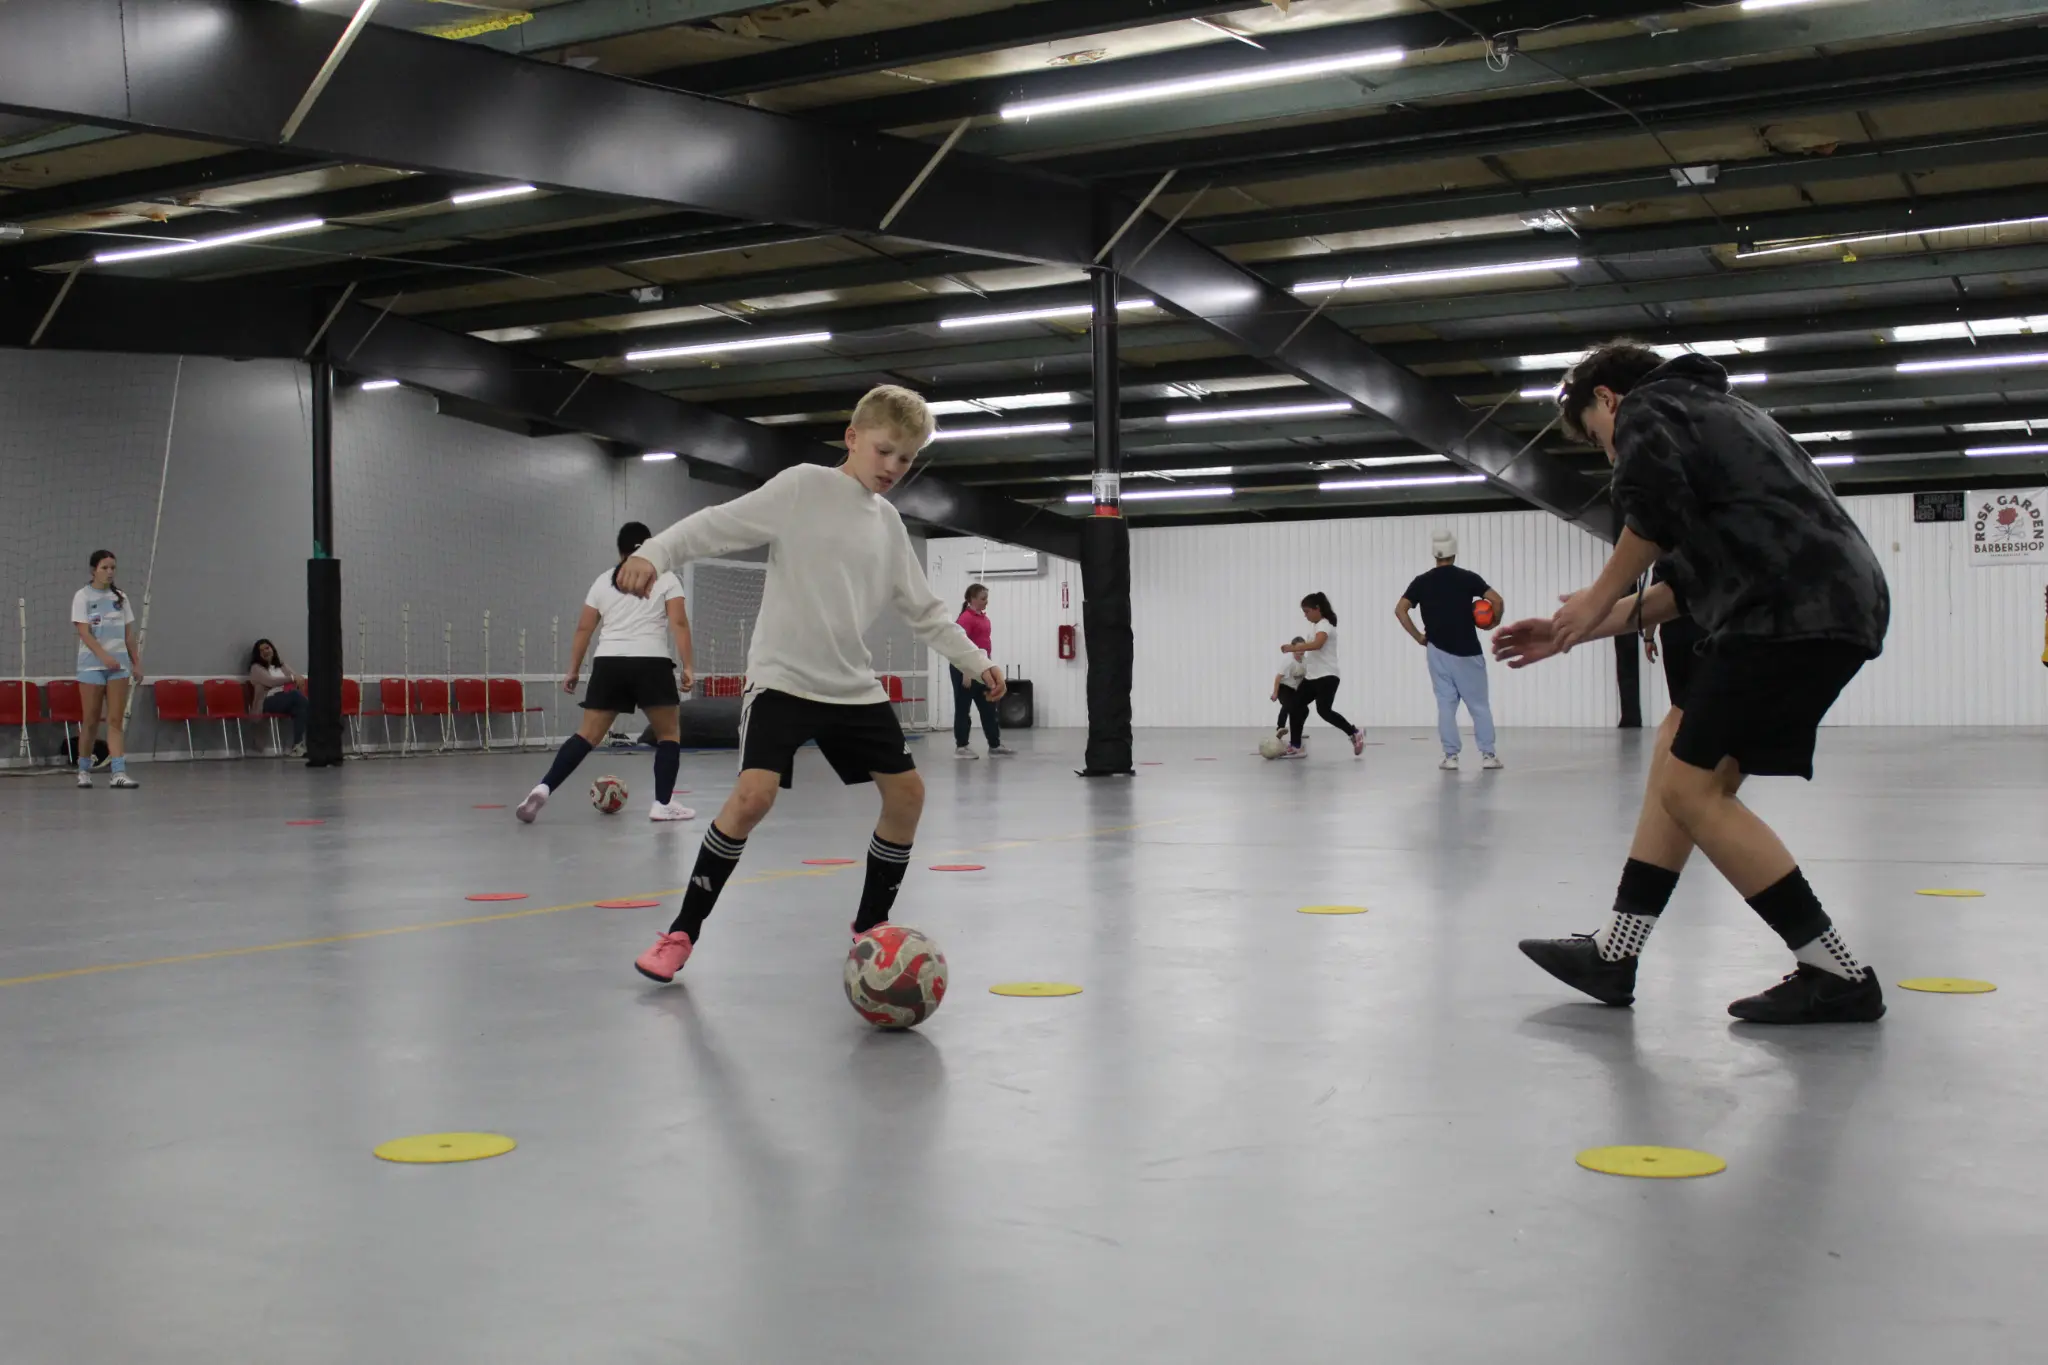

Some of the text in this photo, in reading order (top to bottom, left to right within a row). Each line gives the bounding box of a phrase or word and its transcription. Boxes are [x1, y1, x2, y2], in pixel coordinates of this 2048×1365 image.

[1975, 502, 1994, 541] ROSE
[1997, 495, 2044, 539] GARDEN
[1974, 542, 2044, 553] BARBERSHOP
